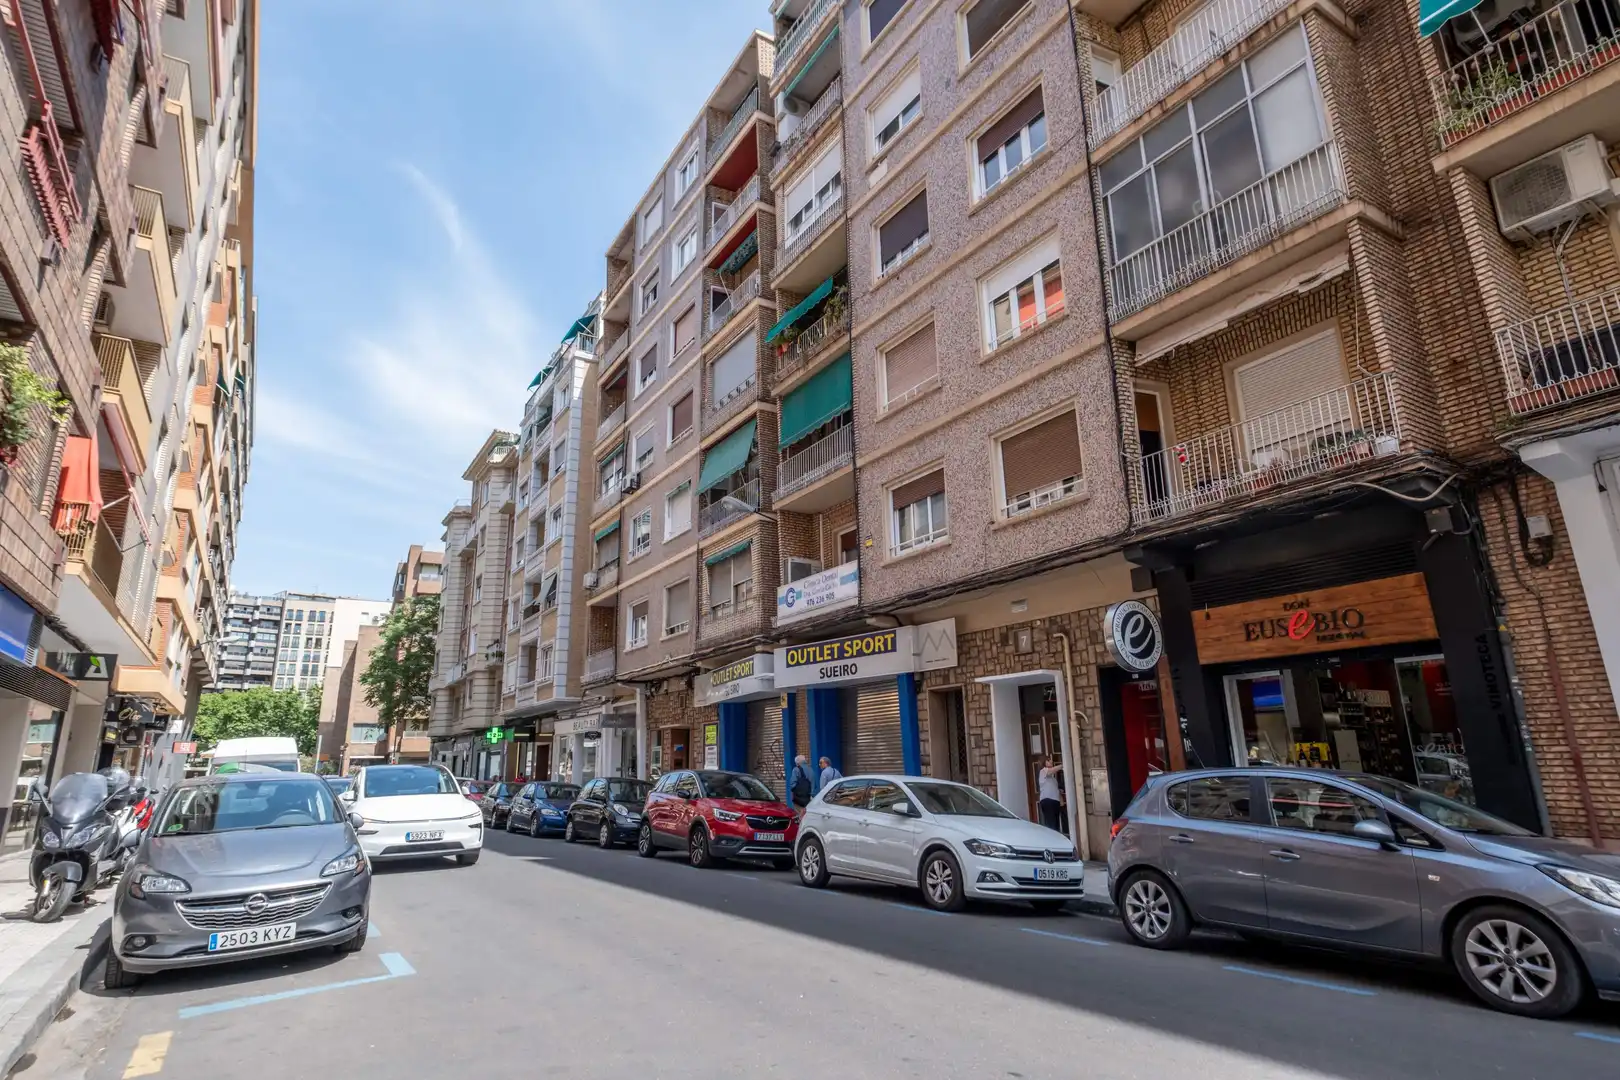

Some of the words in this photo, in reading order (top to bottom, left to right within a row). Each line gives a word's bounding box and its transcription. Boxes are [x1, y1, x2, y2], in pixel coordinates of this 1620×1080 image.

[1282, 599, 1310, 611] DON
[787, 643, 840, 666] OUTLET
[844, 633, 895, 658] SPORT
[1021, 635, 1027, 647] 7
[712, 667, 733, 686] OUTLET
[734, 661, 754, 679] SPORT
[819, 663, 858, 679] SUEIRO
[1475, 633, 1501, 710] VINOTECA
[1038, 869, 1055, 879] 0519
[220, 931, 258, 948] 2503
[263, 925, 292, 942] KYZ
